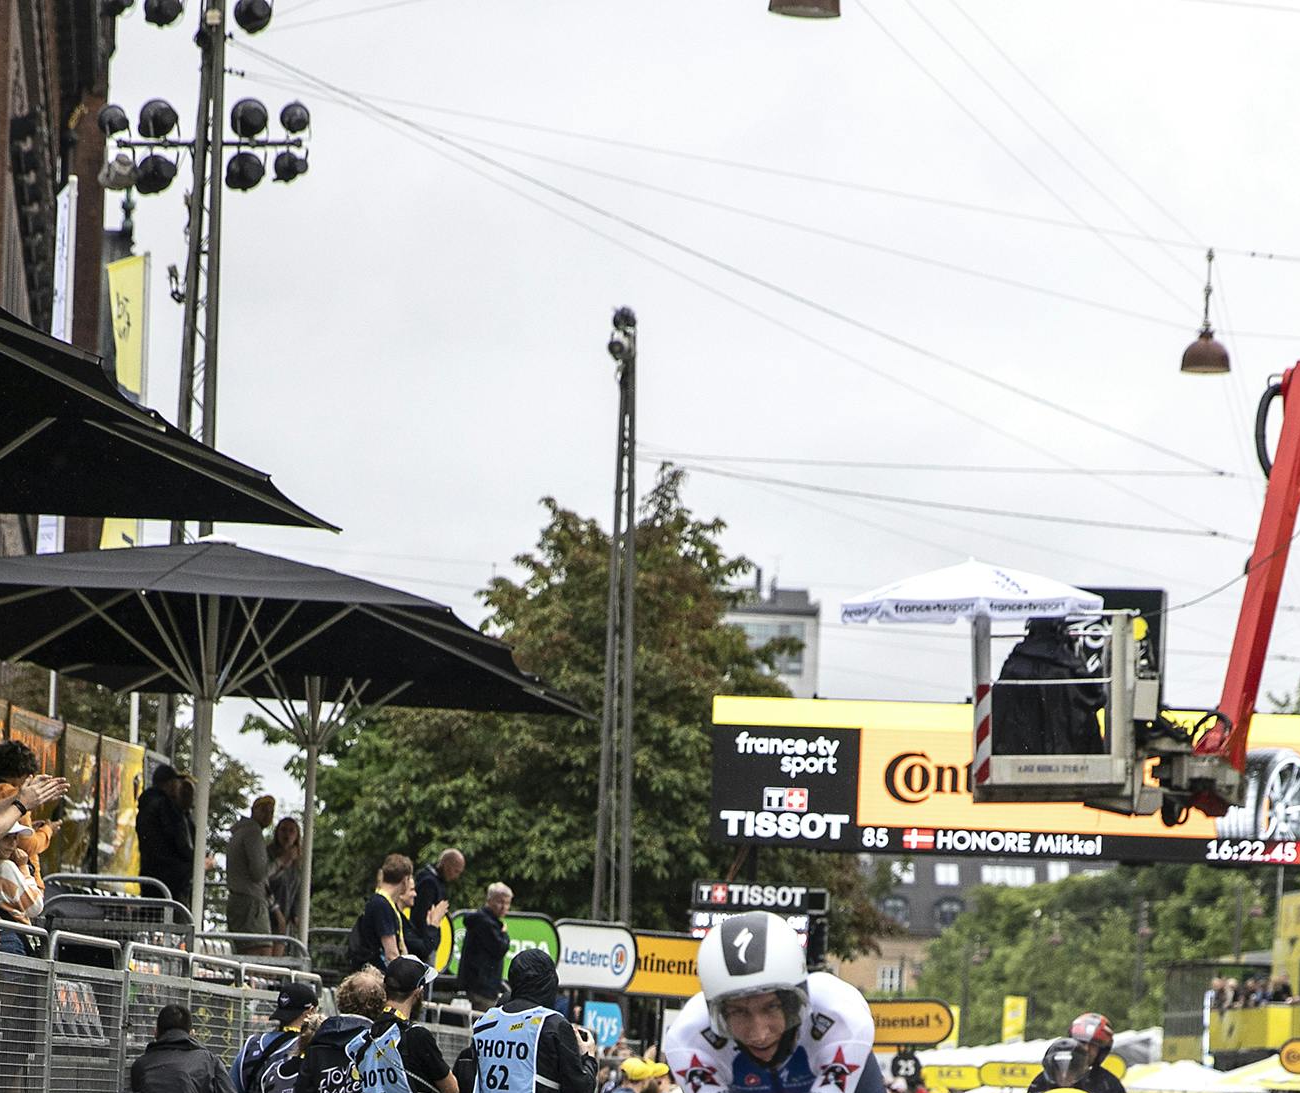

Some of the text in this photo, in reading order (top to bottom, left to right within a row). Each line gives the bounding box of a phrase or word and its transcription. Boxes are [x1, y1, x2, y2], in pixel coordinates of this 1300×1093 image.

[780, 755, 838, 779] sport
[719, 809, 850, 840] TISSOT
[861, 827, 1102, 856] 85 HONORE Mikkel
[1205, 839, 1298, 862] 16:22.45
[728, 884, 807, 907] TISSOT
[564, 947, 609, 968] Leclerc
[586, 1009, 618, 1046] Krys
[873, 1013, 930, 1029] inental
[476, 1038, 529, 1061] PHOTO
[485, 1064, 510, 1091] 62
